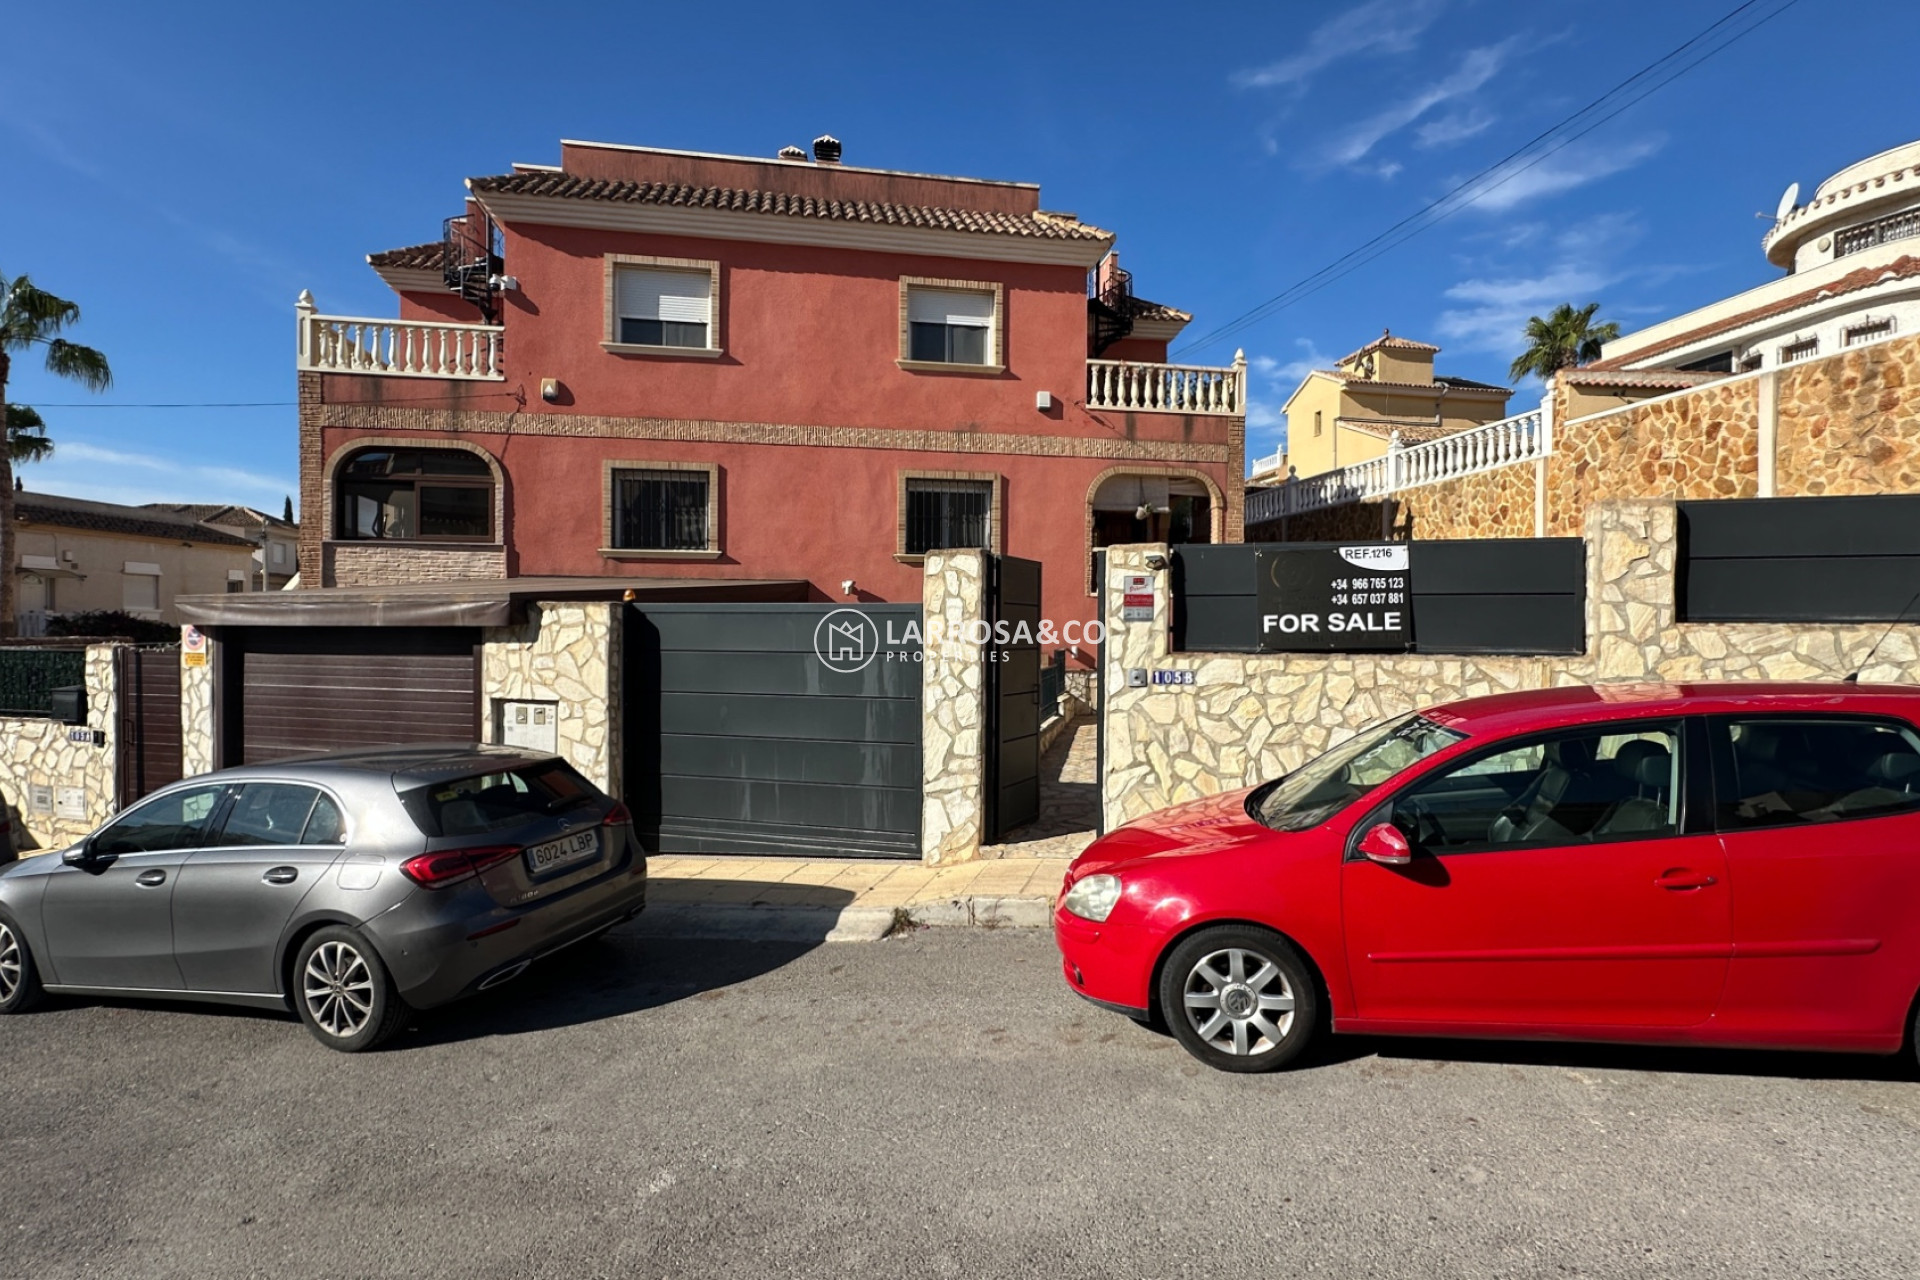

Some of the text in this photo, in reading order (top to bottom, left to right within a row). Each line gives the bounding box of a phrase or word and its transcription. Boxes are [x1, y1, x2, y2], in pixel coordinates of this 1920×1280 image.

[1344, 548, 1393, 560] REF.1216
[1331, 577, 1404, 590] +34 966 765 123
[1331, 593, 1348, 605] +34
[1352, 593, 1368, 605] 657
[1370, 592, 1386, 604] 037
[1388, 592, 1404, 604] 881
[1263, 612, 1402, 634] FOR SALE
[536, 834, 593, 863] 6024 LBP
